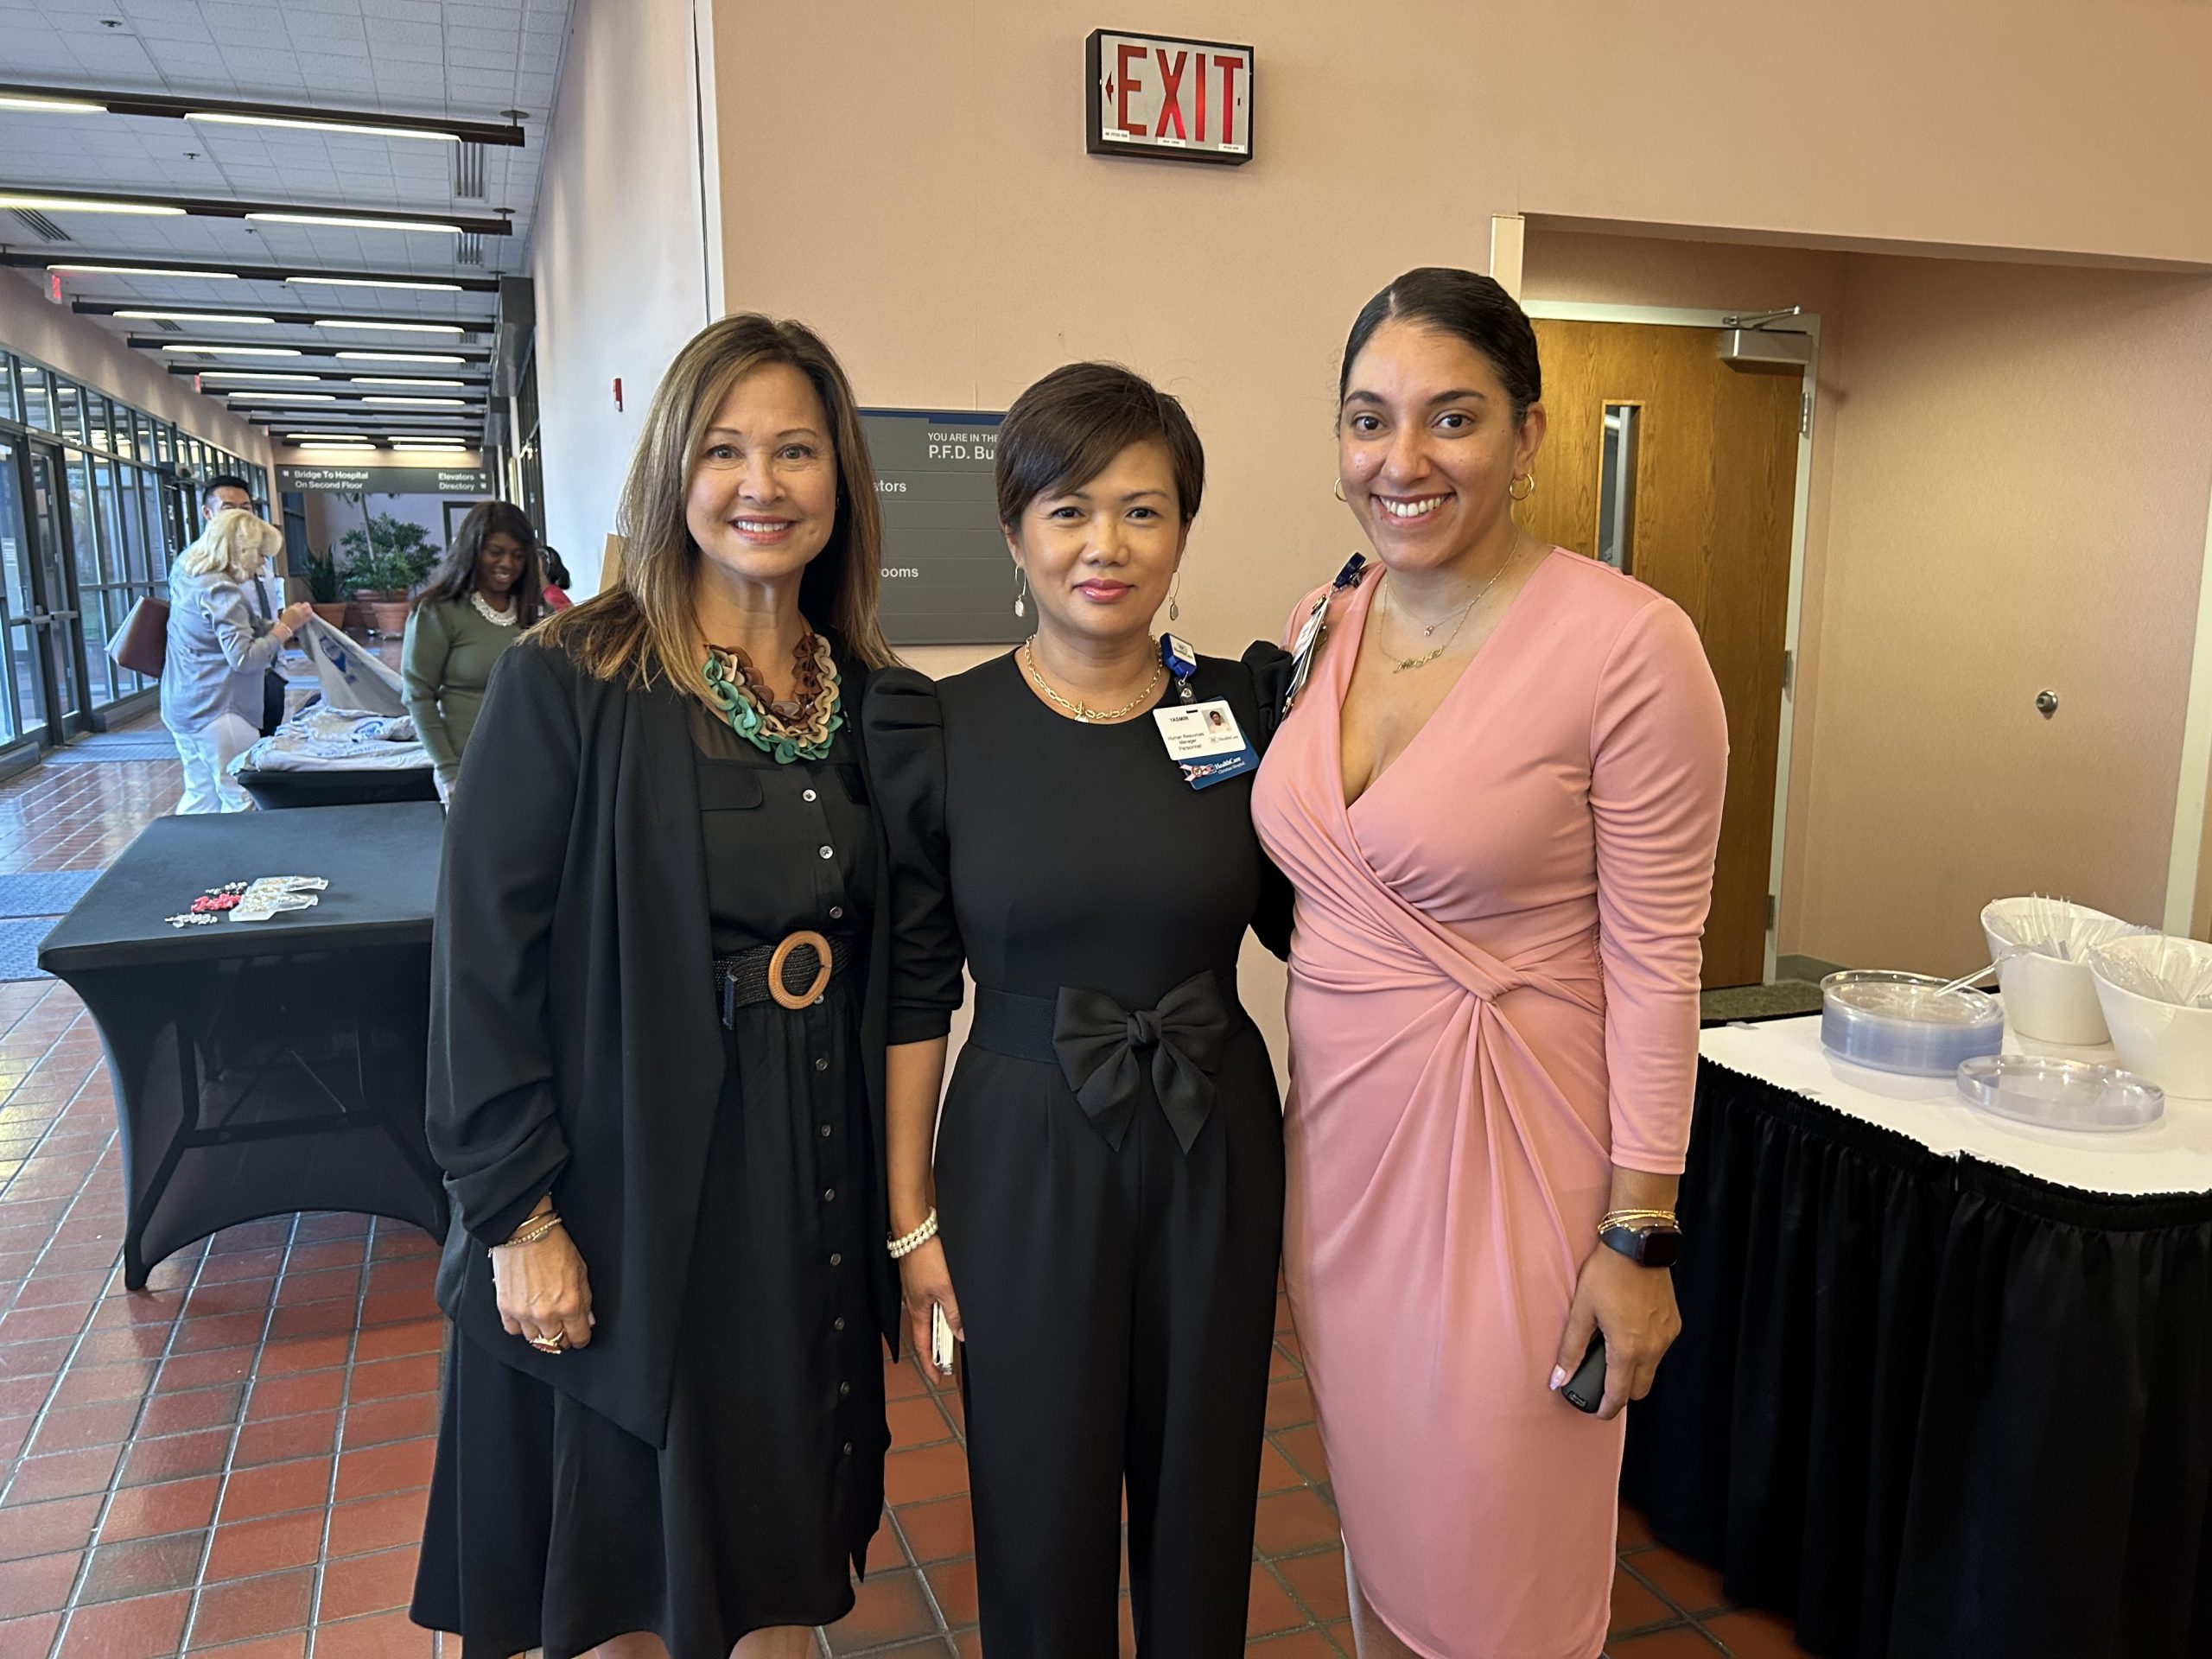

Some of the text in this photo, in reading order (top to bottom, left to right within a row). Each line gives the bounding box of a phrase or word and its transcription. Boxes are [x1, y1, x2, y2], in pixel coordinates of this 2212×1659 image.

[1118, 44, 1243, 144] EXIT
[928, 433, 947, 442] YOU
[950, 433, 968, 442] ARE
[929, 445, 970, 459] P.F.D.
[295, 469, 321, 480] Bridge
[335, 471, 368, 480] Hospital
[439, 482, 474, 492] Directory
[880, 568, 918, 577] ooms
